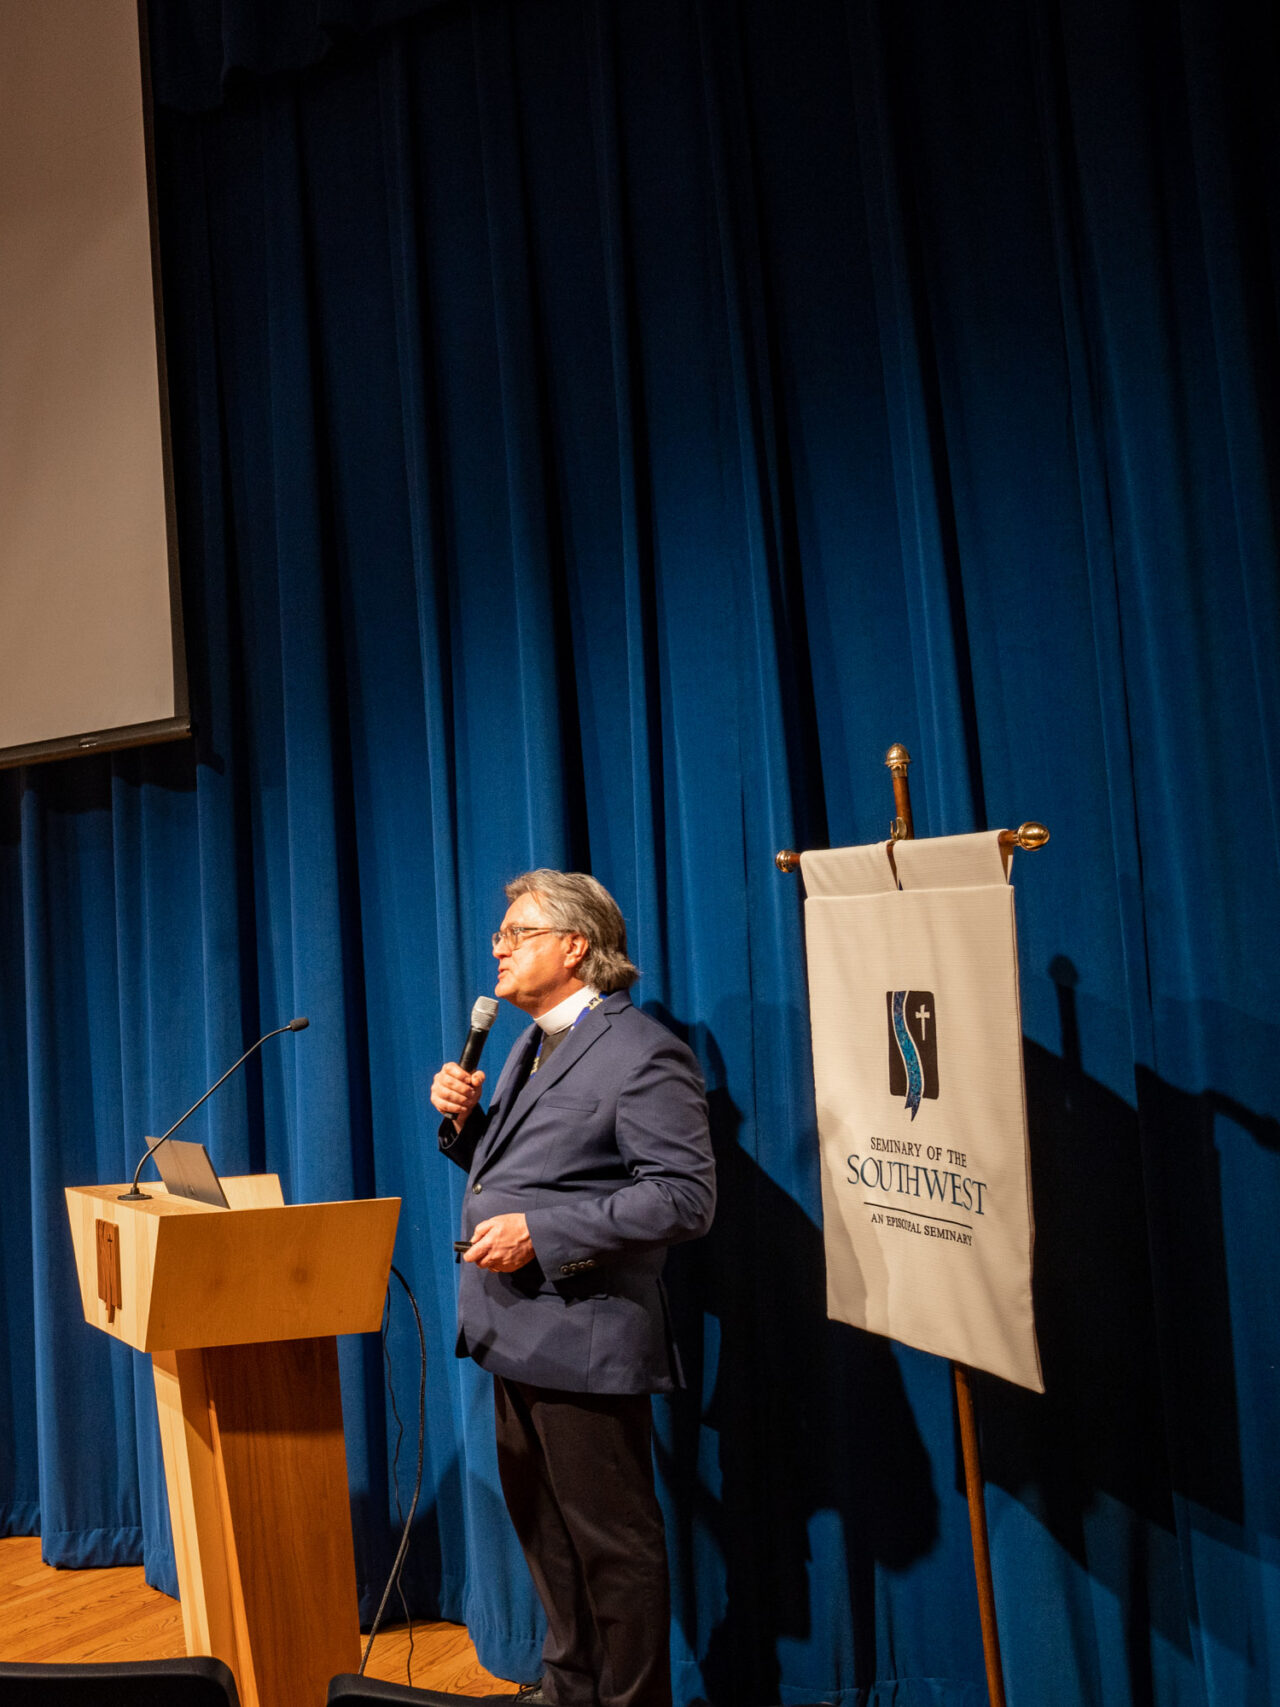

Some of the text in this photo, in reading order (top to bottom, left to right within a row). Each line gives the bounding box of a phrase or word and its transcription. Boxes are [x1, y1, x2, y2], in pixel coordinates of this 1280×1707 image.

[870, 1136, 967, 1168] SEMINARY OF THE
[847, 1154, 987, 1216] SOUTHWEST
[871, 1212, 973, 1246] AN EPISCOPAL SEMINARY
